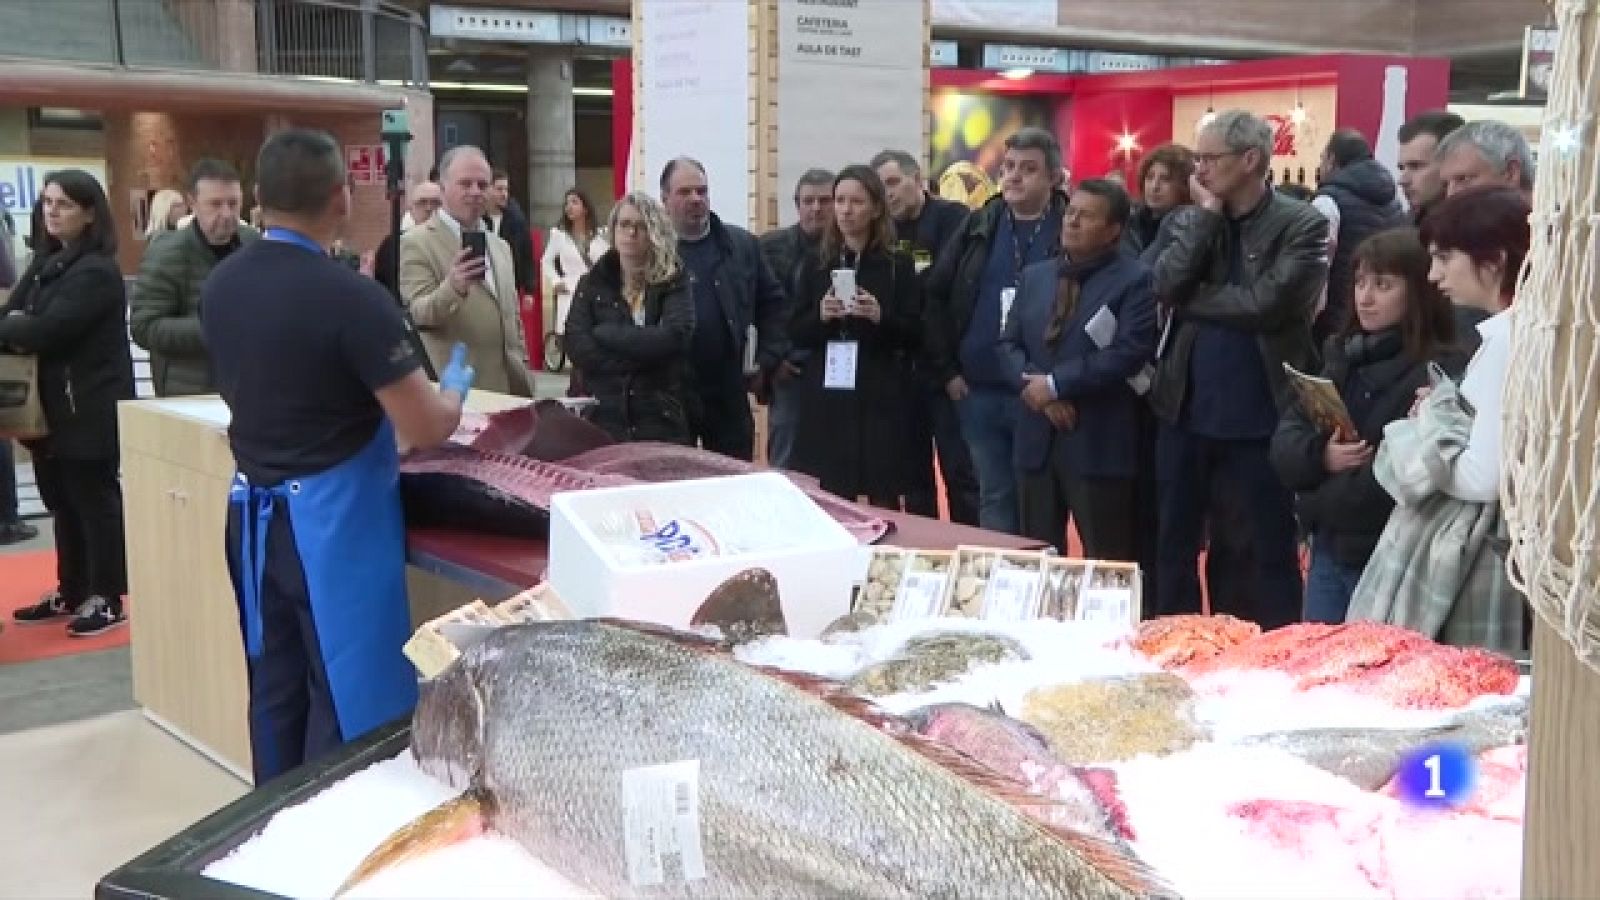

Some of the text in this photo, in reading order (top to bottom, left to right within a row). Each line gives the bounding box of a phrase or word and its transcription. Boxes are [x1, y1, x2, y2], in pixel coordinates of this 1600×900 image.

[797, 14, 848, 28] CAFETERIA
[797, 43, 823, 54] AULA
[824, 44, 838, 55] DE
